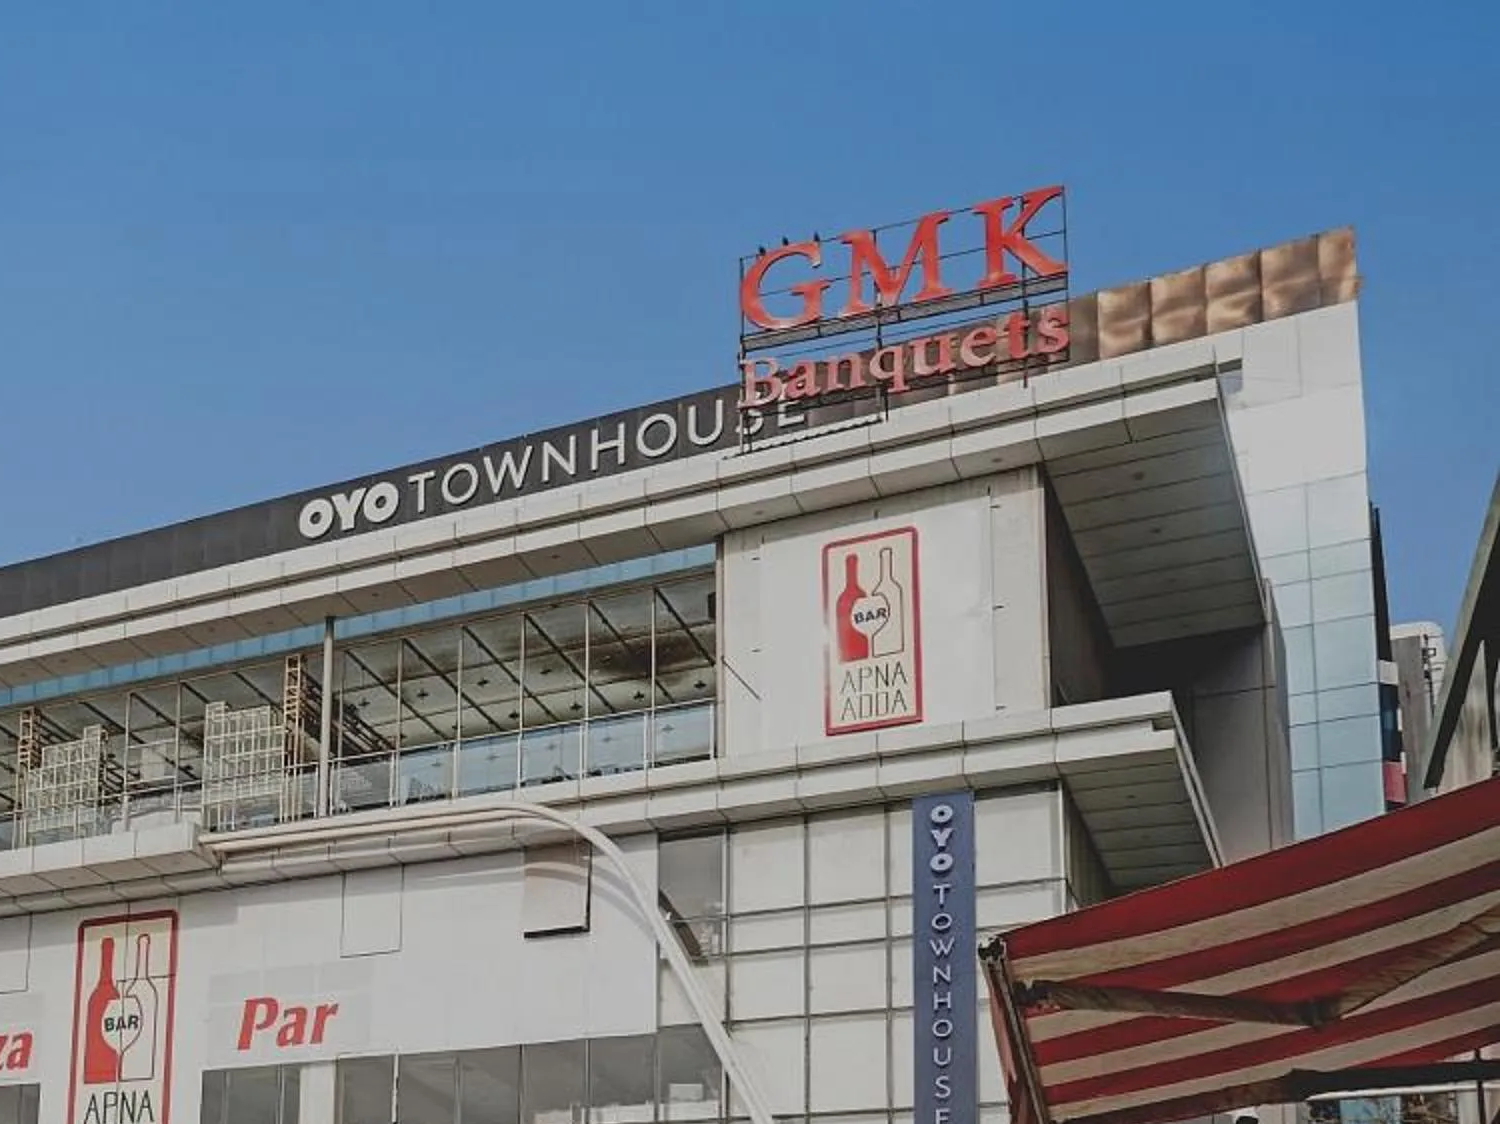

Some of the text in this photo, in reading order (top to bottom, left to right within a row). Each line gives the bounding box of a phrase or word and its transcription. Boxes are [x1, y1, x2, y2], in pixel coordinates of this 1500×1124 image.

[740, 184, 1068, 332] GMK
[739, 306, 1070, 410] Banquets
[299, 479, 399, 539] OYO
[854, 607, 887, 625] BAR
[840, 661, 908, 695] APNA
[841, 689, 908, 722] ADDA
[929, 804, 954, 871] OYO
[103, 1014, 141, 1033] BAR
[237, 996, 340, 1051] Par
